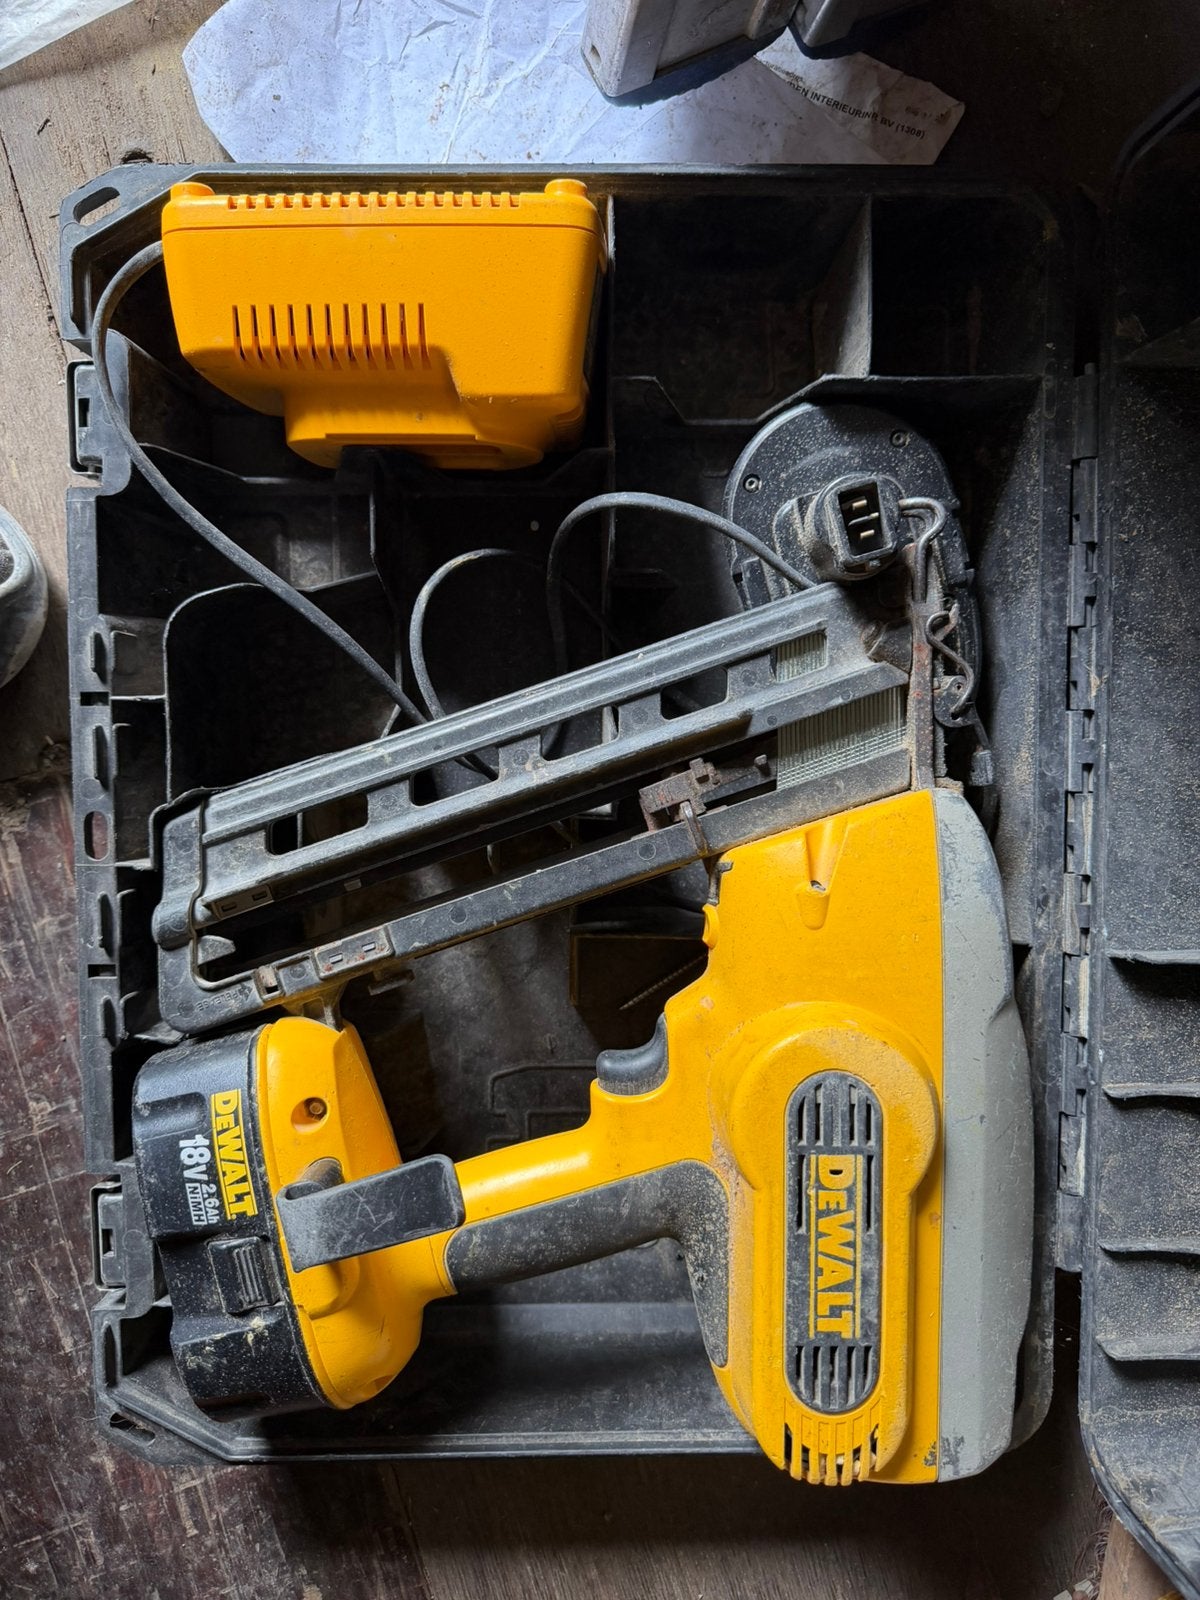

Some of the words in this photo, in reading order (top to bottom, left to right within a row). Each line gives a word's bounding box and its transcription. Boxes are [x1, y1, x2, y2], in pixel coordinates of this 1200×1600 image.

[880, 117, 895, 128] BV
[187, 1184, 206, 1224] NiMH
[201, 1183, 220, 1224] 2.6Ah
[816, 1154, 856, 1339] DEWALT
